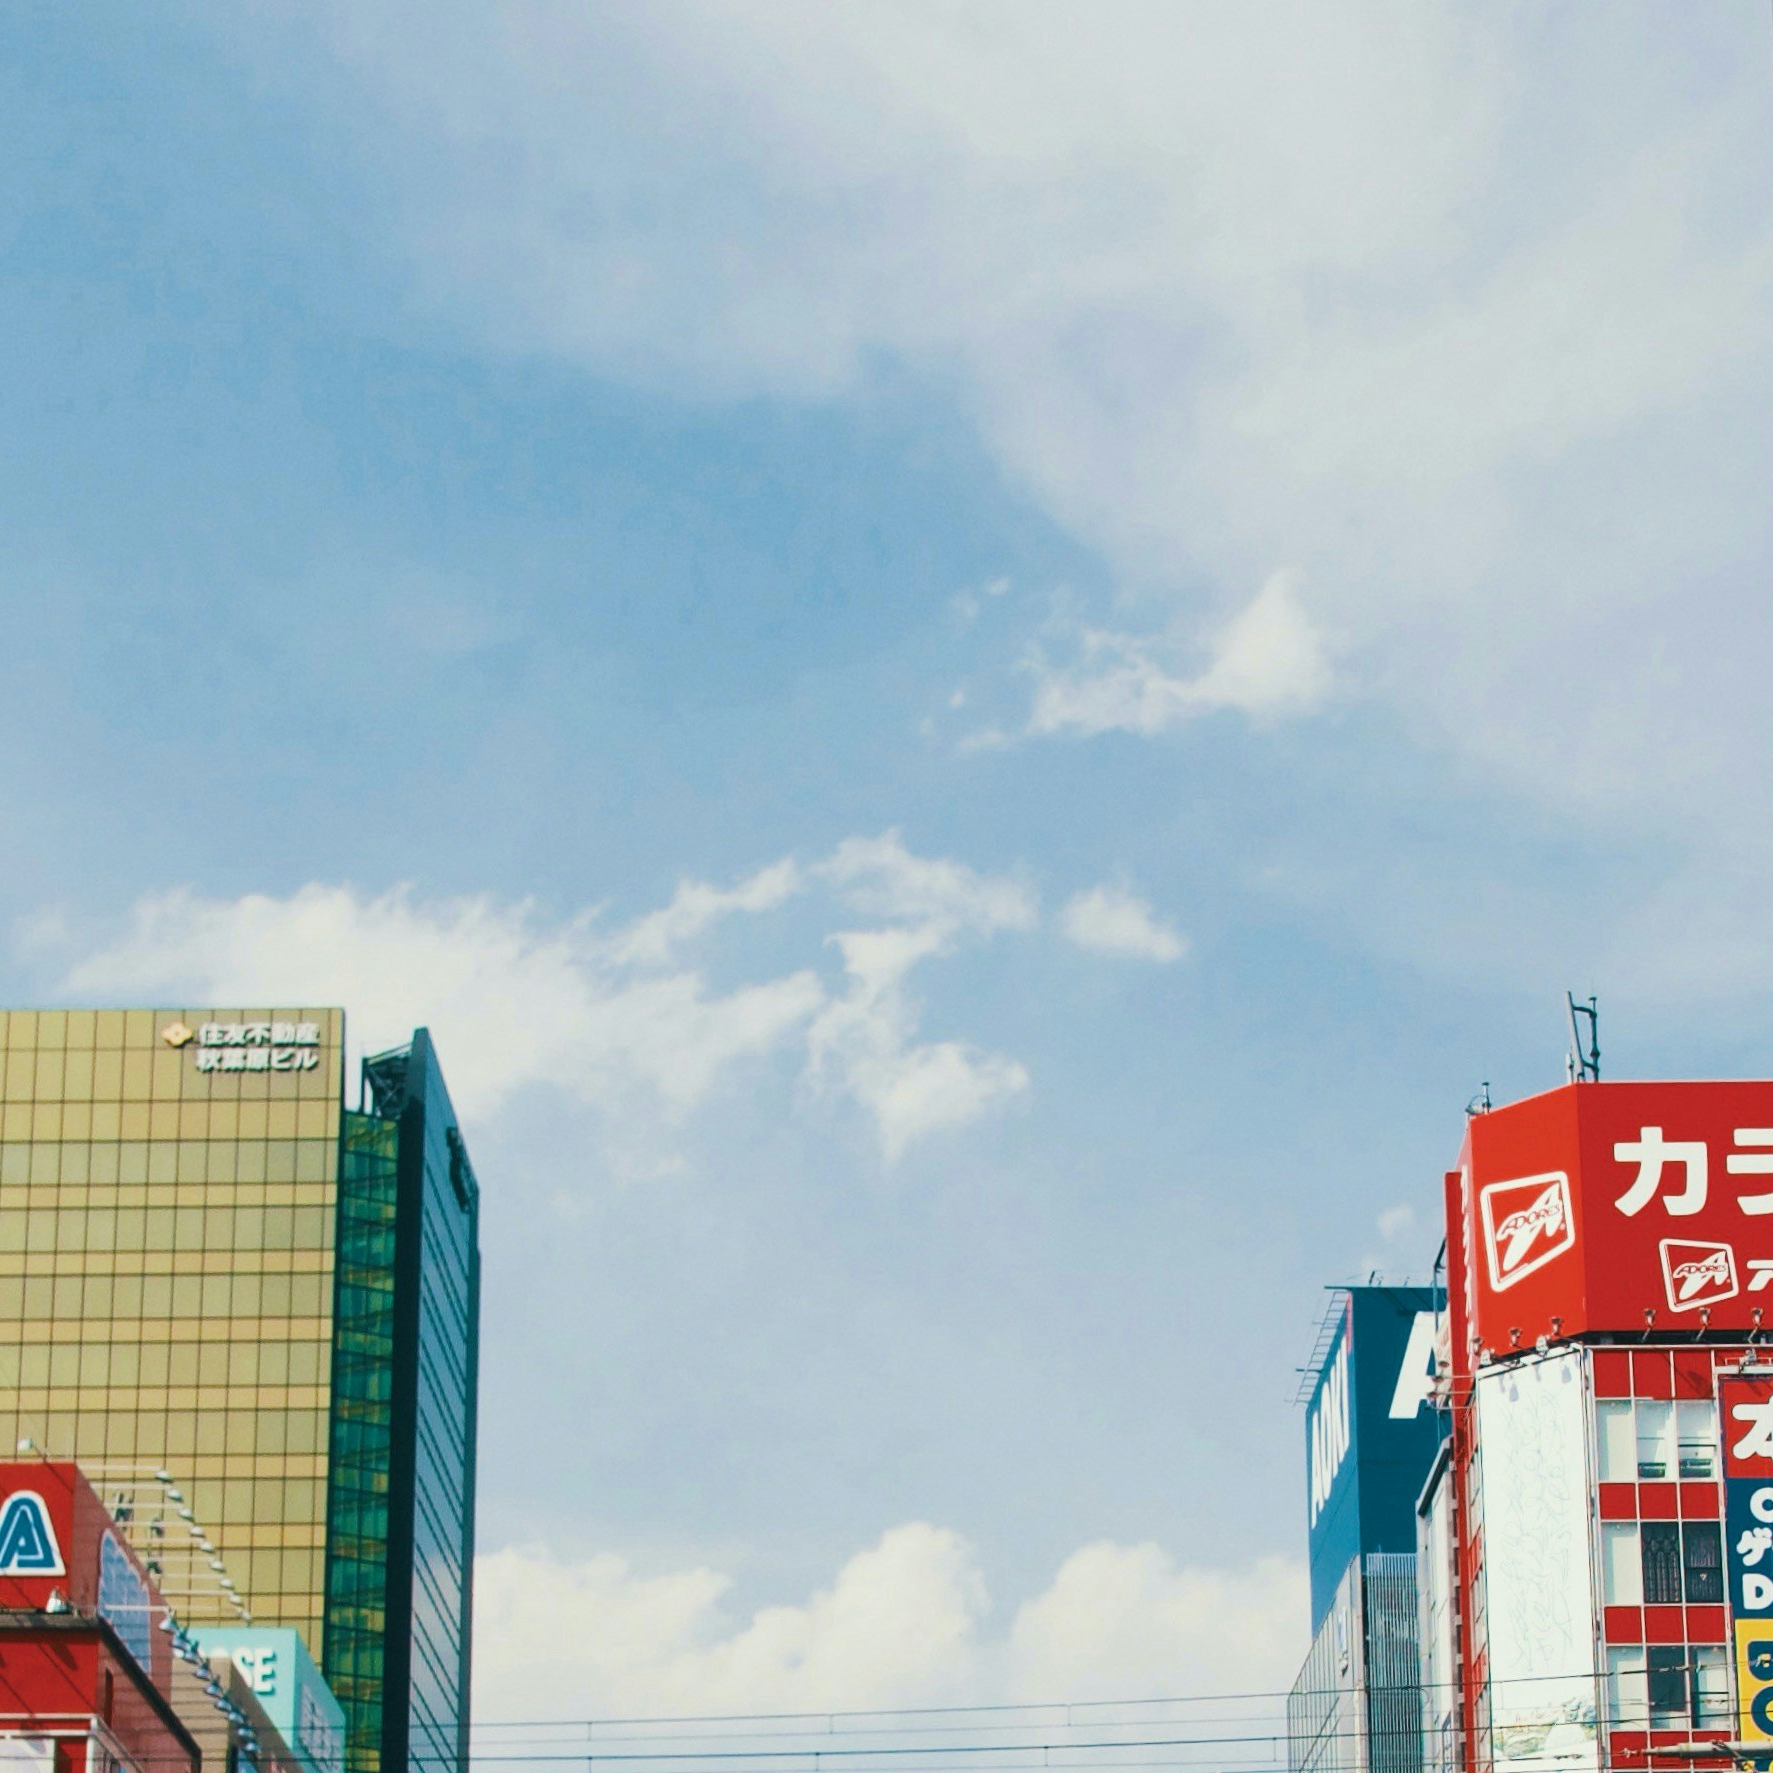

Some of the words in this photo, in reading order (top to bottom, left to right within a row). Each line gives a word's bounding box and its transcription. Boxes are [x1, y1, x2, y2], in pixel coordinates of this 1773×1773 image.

[197, 1022, 319, 1048] 住友不動産
